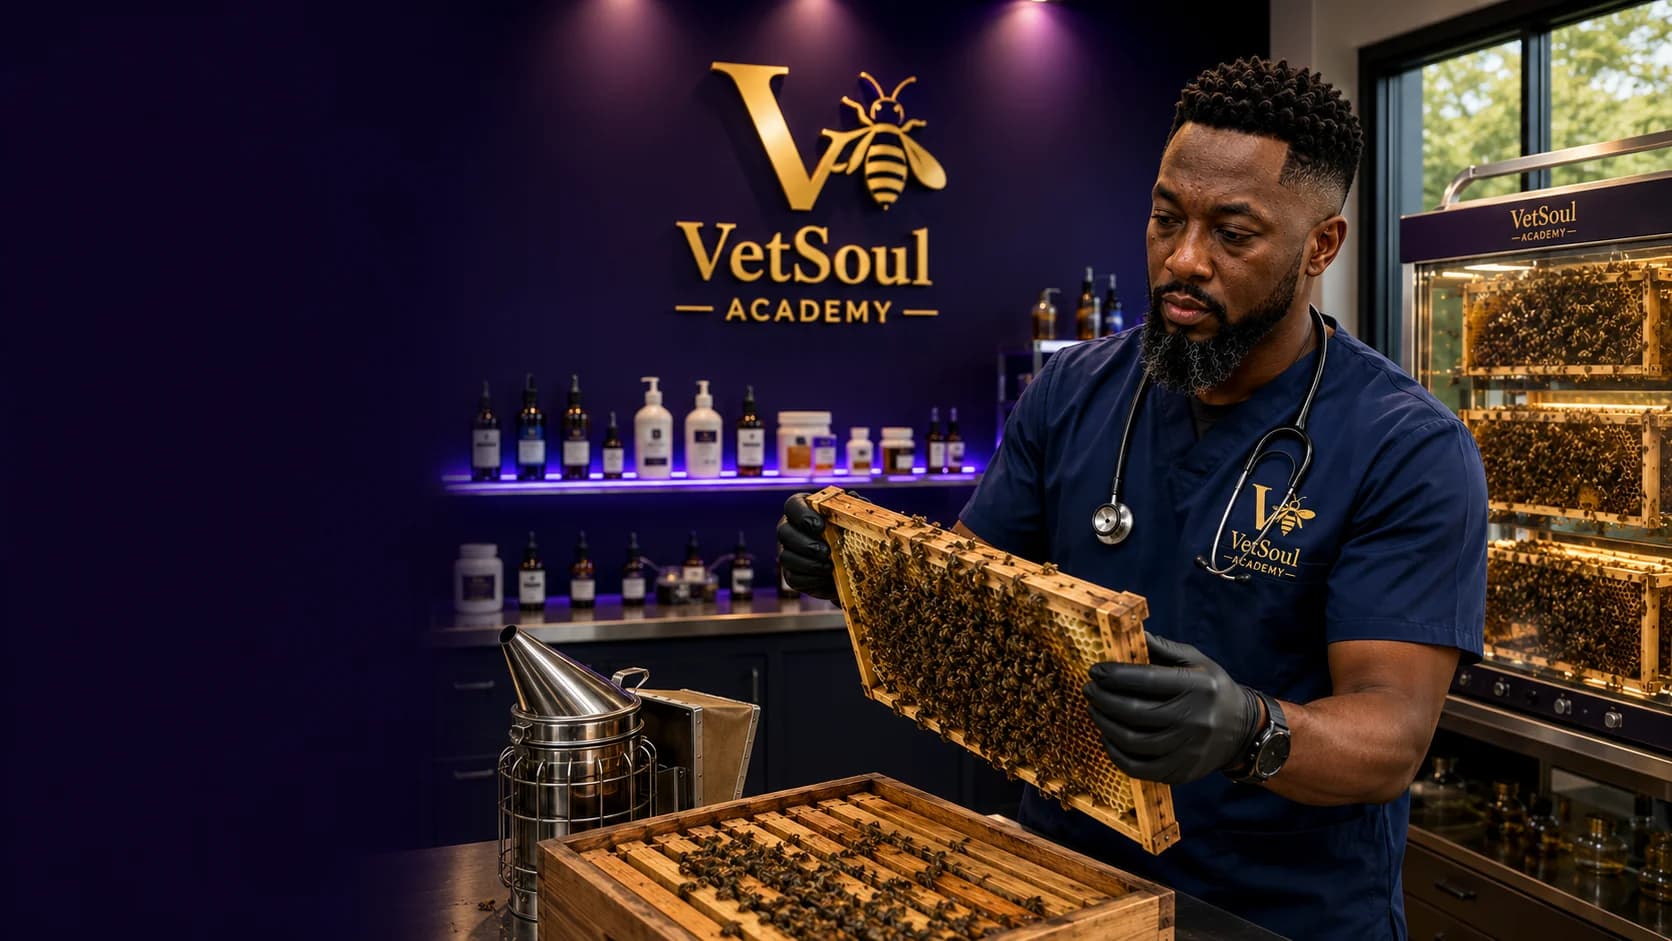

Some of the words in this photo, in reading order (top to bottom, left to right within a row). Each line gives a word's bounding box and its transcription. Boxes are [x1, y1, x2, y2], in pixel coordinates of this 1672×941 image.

[1510, 201, 1576, 229] VetSoul
[1521, 228, 1566, 241] ACADEMY
[675, 221, 933, 287] VetSoul
[725, 298, 892, 324] ACADEMY
[1231, 530, 1301, 568] VetSoul
[1231, 556, 1285, 577] ACADEMY
